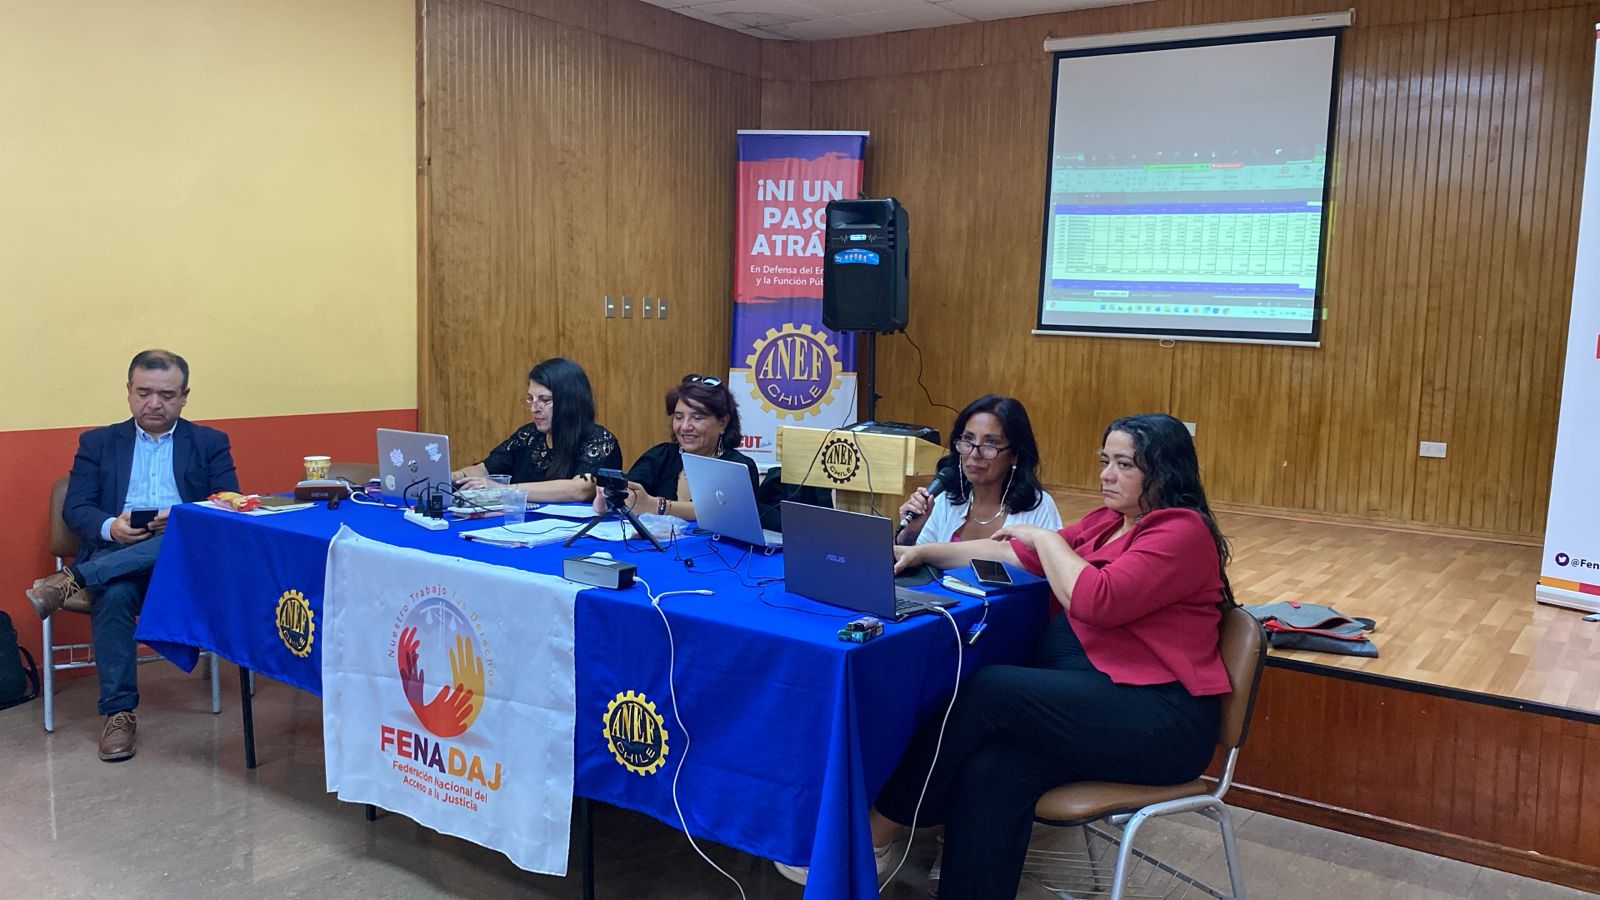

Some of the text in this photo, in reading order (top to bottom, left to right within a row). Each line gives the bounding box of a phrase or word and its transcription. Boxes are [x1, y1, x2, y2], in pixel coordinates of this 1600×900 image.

[803, 179, 843, 202] UN
[751, 230, 824, 257] ATRÁ
[750, 265, 761, 273] En
[763, 265, 797, 274] Defensa
[800, 266, 813, 274] del
[756, 278, 762, 286] y
[773, 277, 807, 286] Función
[758, 336, 824, 381] ANEF
[767, 384, 823, 406] CHILE
[827, 443, 854, 466] ANEF
[1571, 558, 1600, 569] @Fen
[388, 604, 409, 658] Nuestro
[409, 584, 447, 602] Trabajo
[611, 703, 655, 745] ANEF
[381, 724, 502, 791] FENADAJ
[616, 741, 656, 764] CHILE
[392, 760, 488, 804] Federación Nacional del
[403, 775, 478, 812] Acceso a la Justicia
